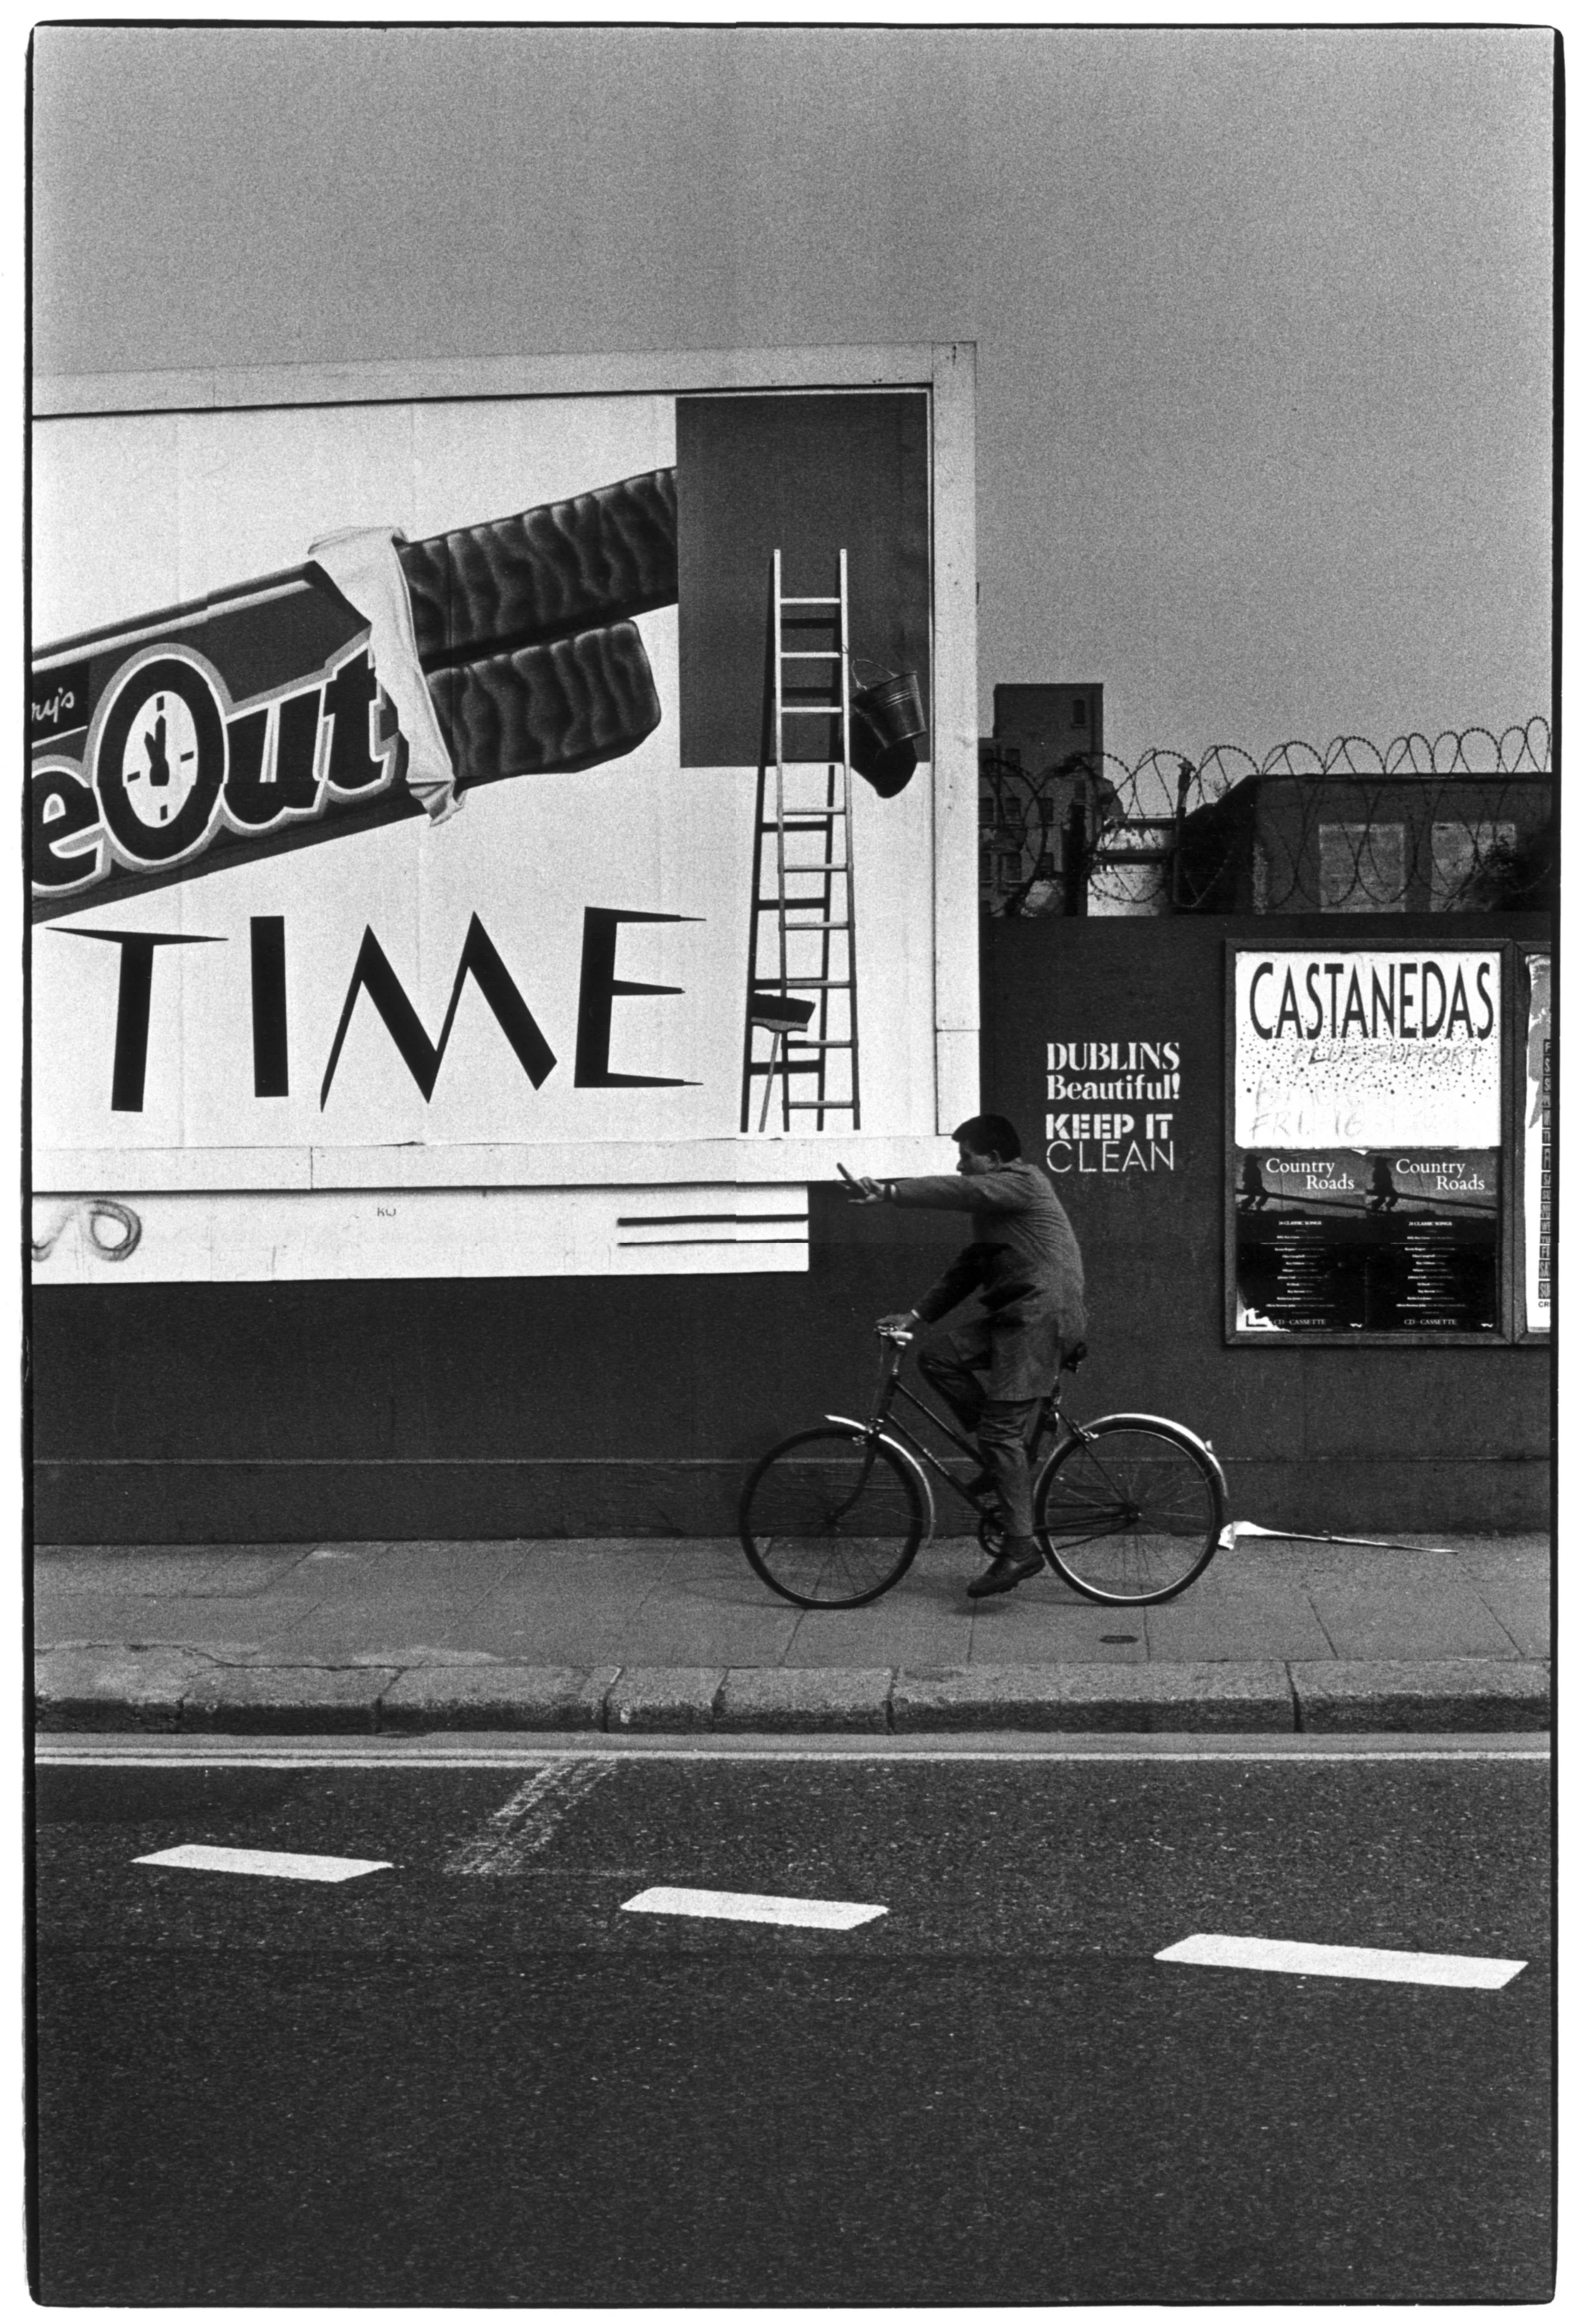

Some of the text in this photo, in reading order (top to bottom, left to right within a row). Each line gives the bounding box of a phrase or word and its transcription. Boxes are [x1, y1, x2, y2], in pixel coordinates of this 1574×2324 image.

[45, 906, 706, 1112] TIME
[1250, 961, 1494, 1040] CASTANEDAS
[1046, 1042, 1180, 1070] DUBLINS
[1046, 1072, 1180, 1100] Beautiful!
[1046, 1114, 1174, 1140] KEEP IT
[1046, 1140, 1174, 1173] CLEAN
[1265, 1158, 1335, 1178] Country
[1396, 1158, 1466, 1179] Country
[1306, 1172, 1355, 1190] Roads
[1436, 1173, 1485, 1190] Roads
